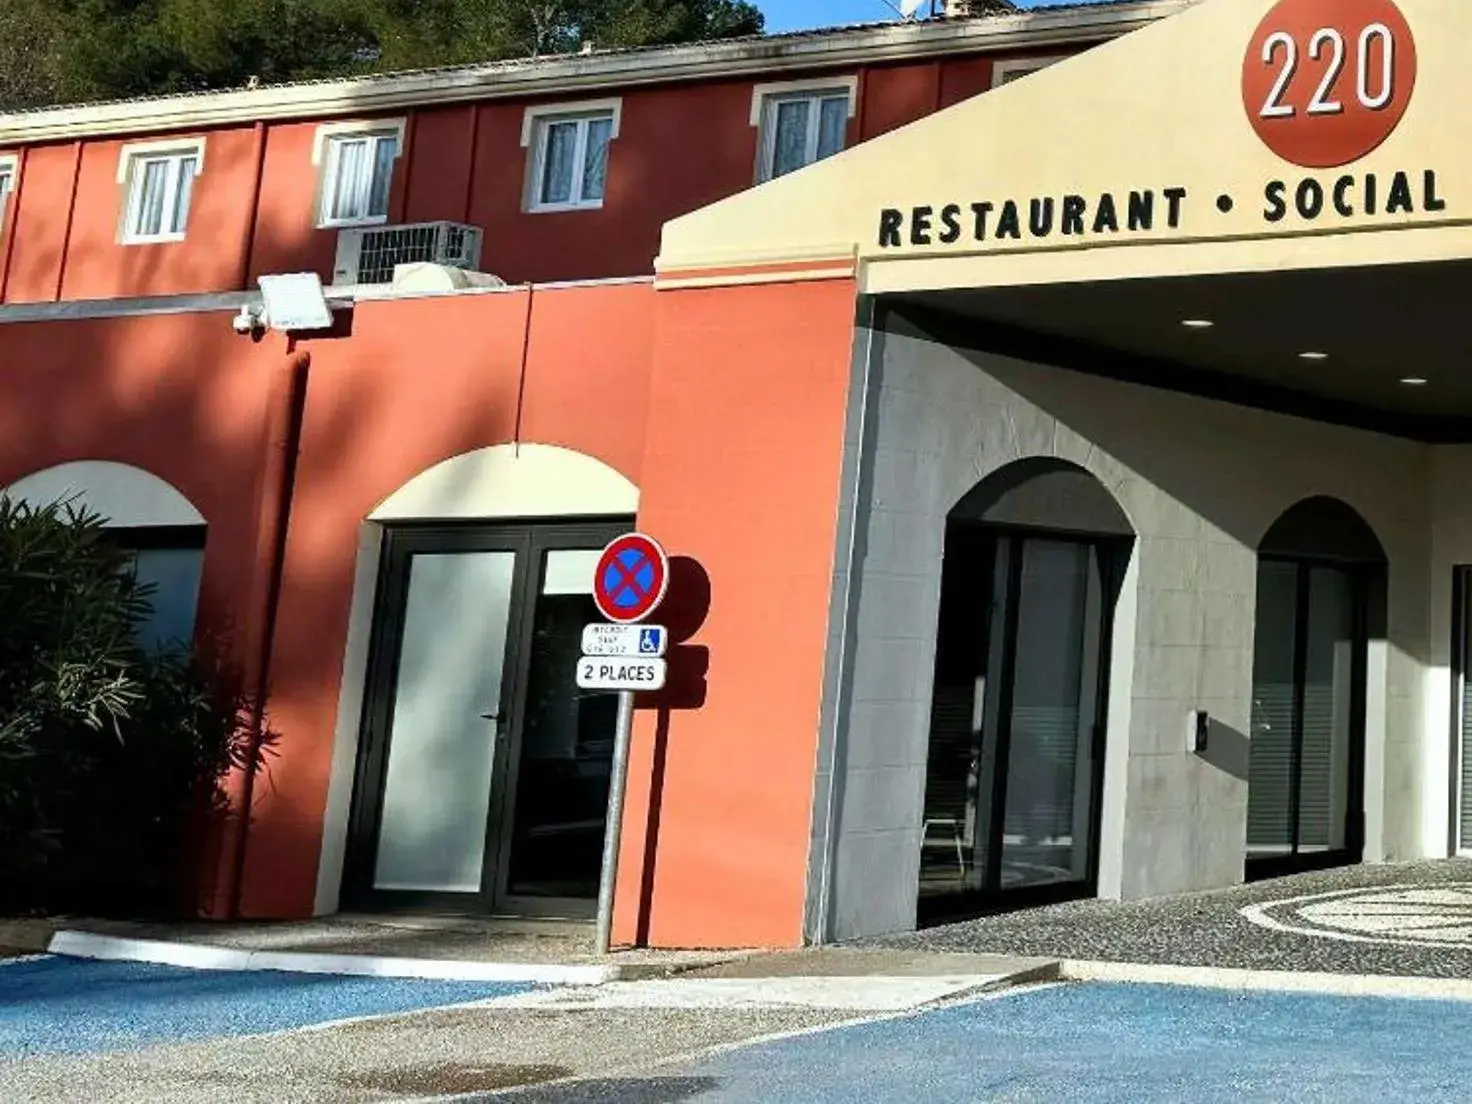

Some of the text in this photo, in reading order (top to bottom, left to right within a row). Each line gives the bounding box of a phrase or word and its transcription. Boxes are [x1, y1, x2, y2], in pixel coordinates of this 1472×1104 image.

[1259, 22, 1396, 120] 220
[878, 187, 1187, 247] RESTAURANT
[1263, 169, 1446, 223] SOCIAL
[583, 664, 655, 681] 2 PLACES
